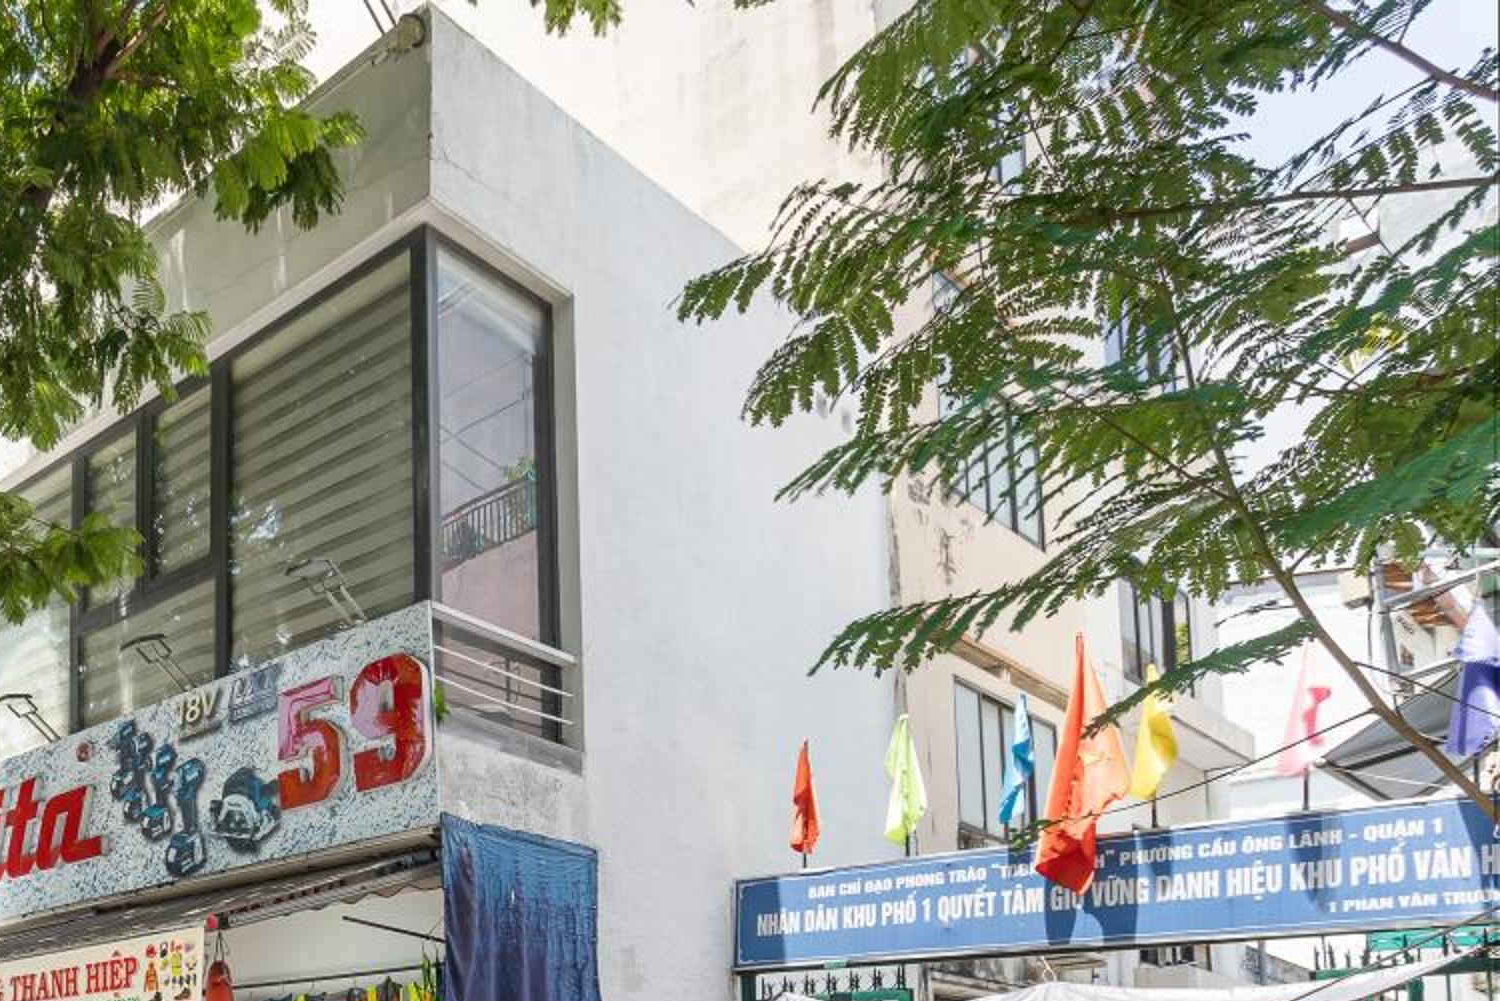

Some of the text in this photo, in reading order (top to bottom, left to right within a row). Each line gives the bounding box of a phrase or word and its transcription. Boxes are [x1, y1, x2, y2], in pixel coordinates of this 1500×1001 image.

[277, 652, 432, 811] 59
[842, 902, 878, 928] KHU
[921, 898, 931, 921] 1
[1155, 870, 1219, 903] DANH
[1290, 858, 1342, 892] KHU
[896, 872, 944, 890] PHONG
